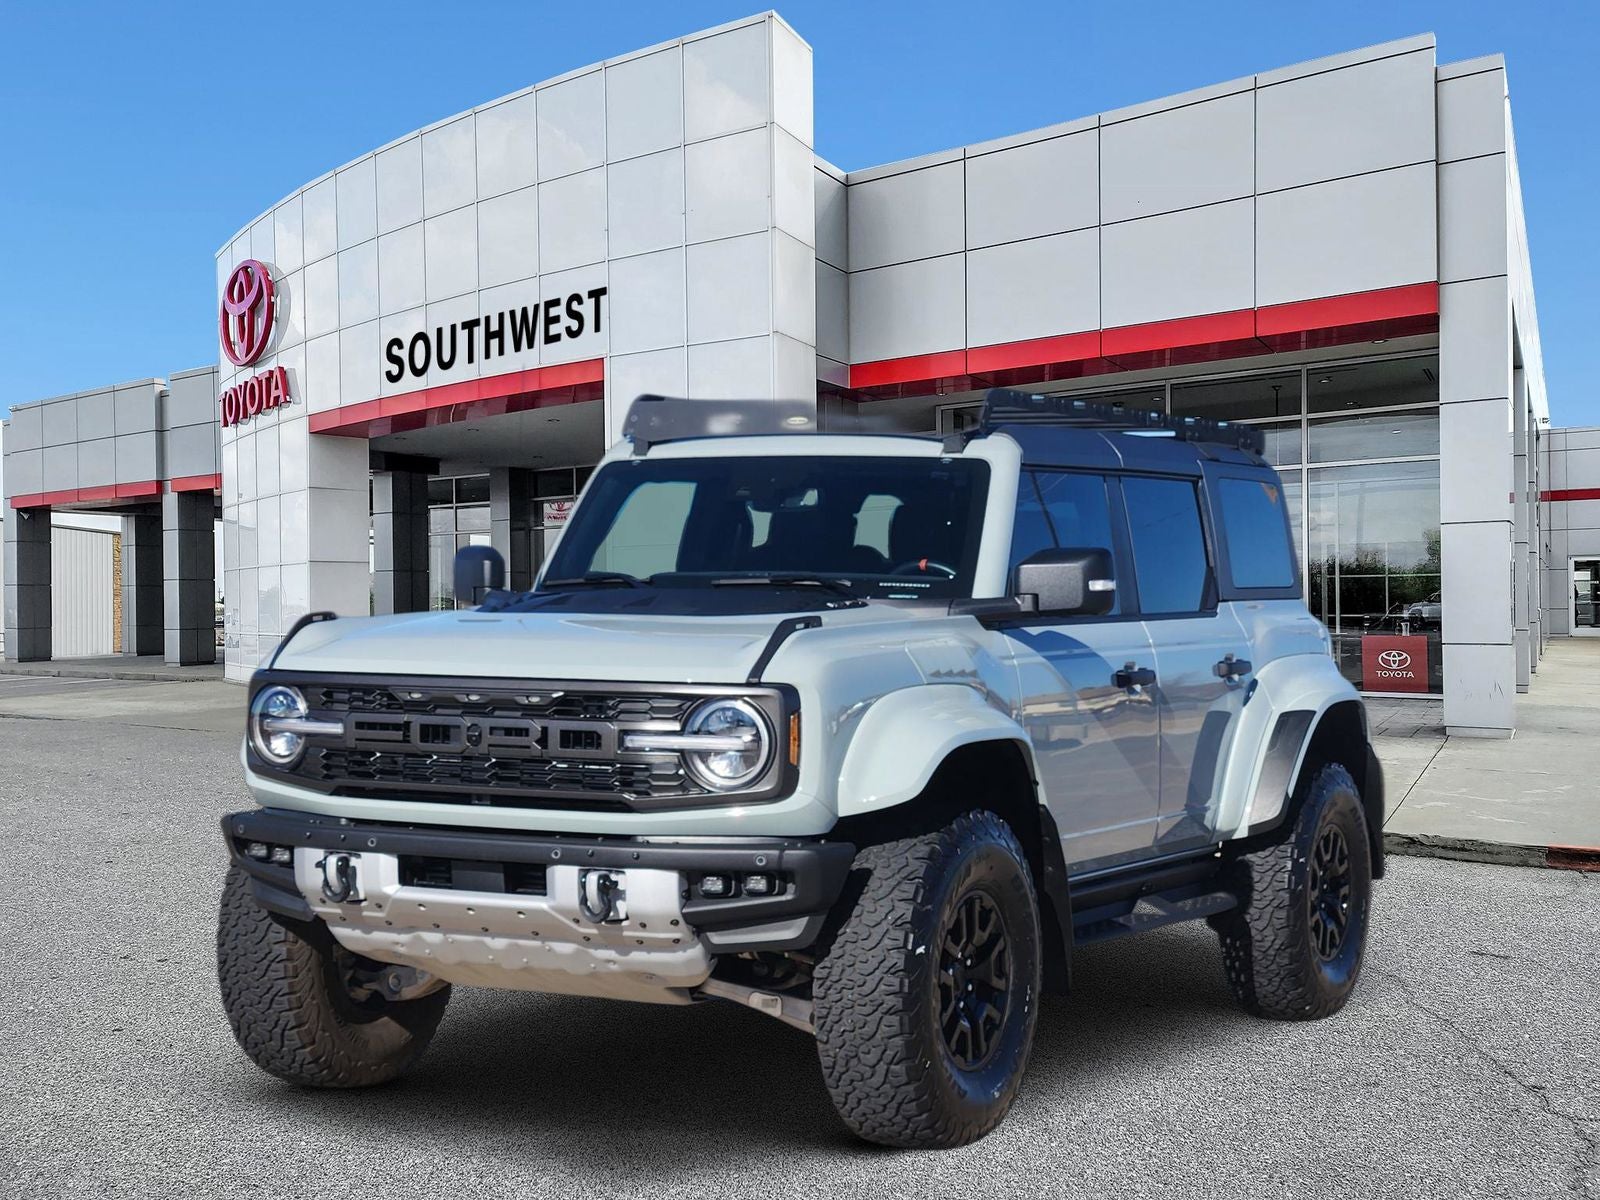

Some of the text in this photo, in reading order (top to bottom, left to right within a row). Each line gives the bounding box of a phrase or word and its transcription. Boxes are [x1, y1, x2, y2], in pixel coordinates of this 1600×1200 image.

[385, 286, 608, 384] SOUTHWEST
[218, 366, 290, 428] TOYOTA
[1375, 670, 1415, 678] TOYOTA
[346, 712, 618, 760] FORD
